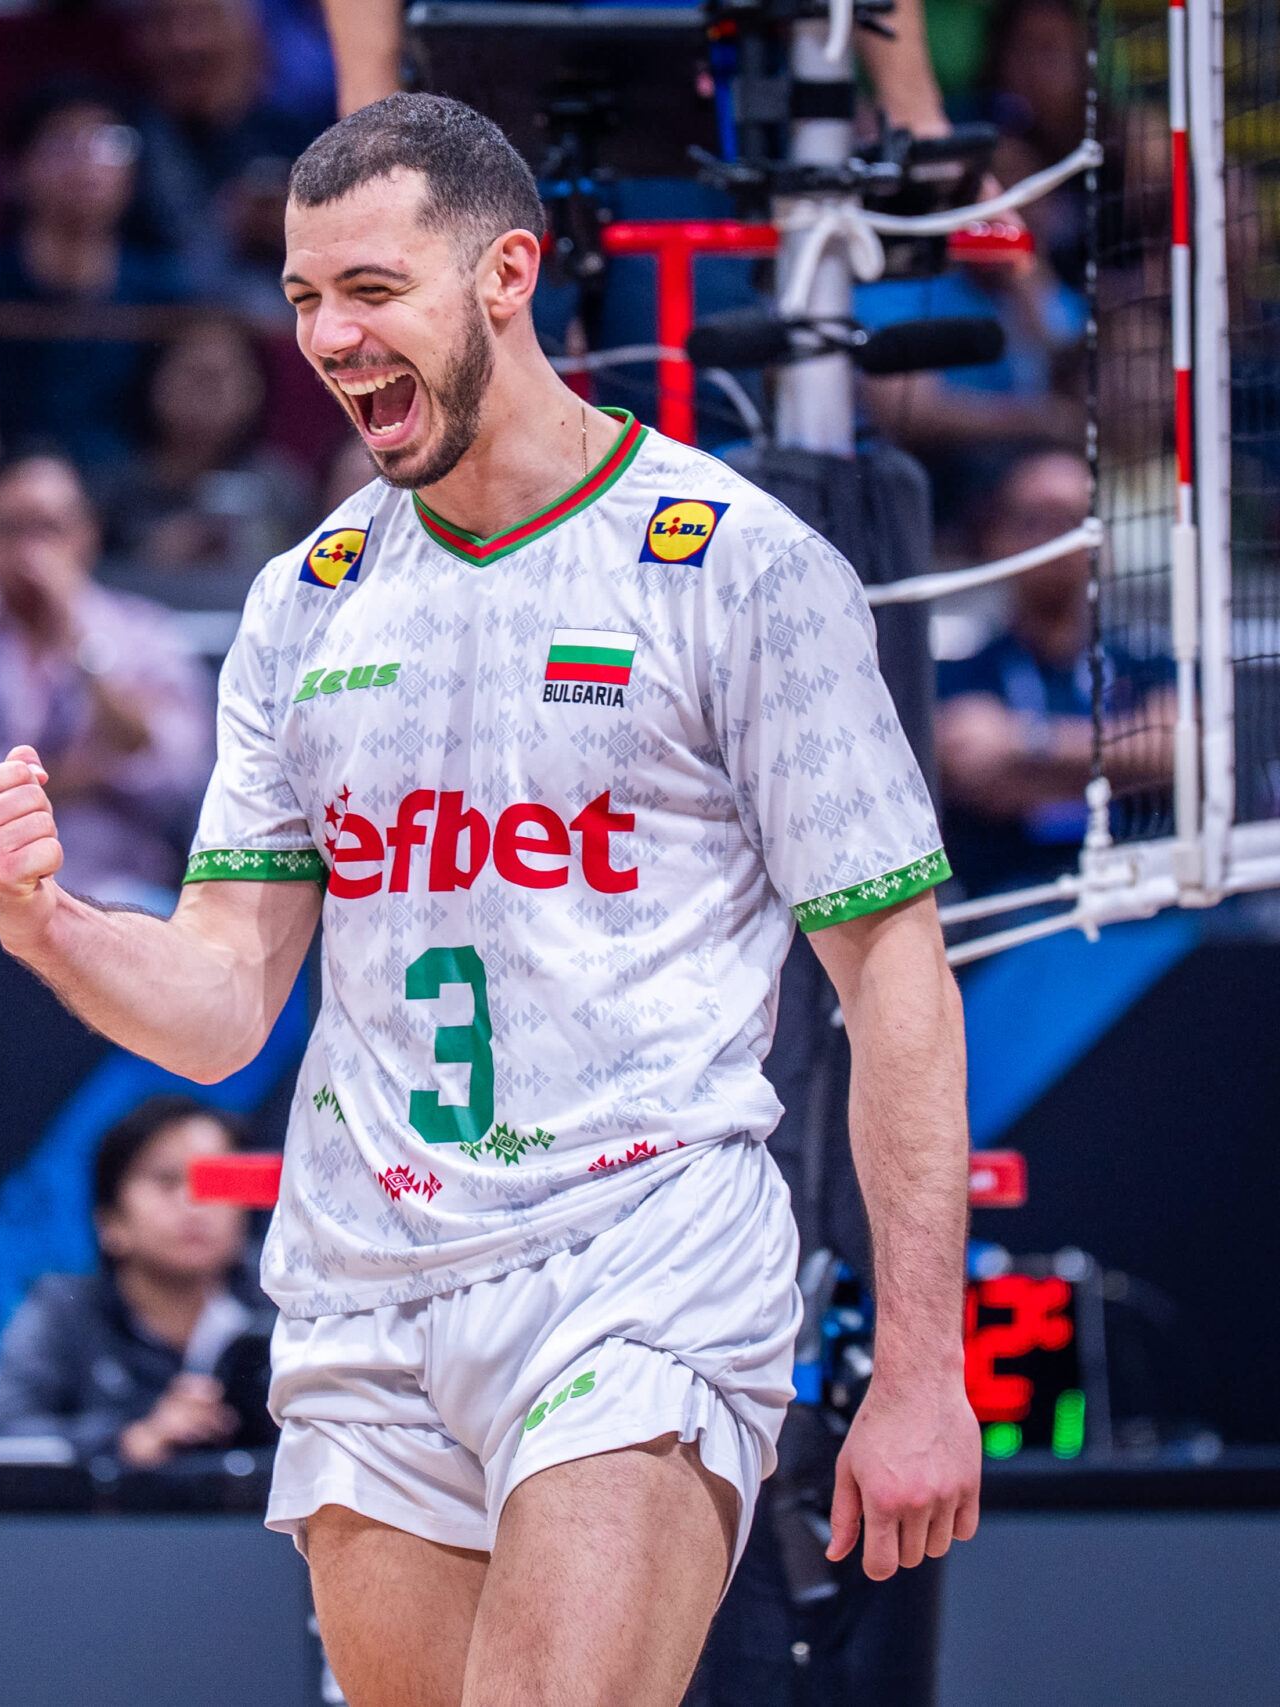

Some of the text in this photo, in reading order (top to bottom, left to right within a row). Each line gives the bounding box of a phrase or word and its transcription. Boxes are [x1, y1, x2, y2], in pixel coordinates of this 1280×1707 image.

[293, 663, 401, 704] Zeus
[542, 683, 624, 708] BULGARIA
[327, 788, 639, 900] efbet
[405, 944, 495, 1144] 3
